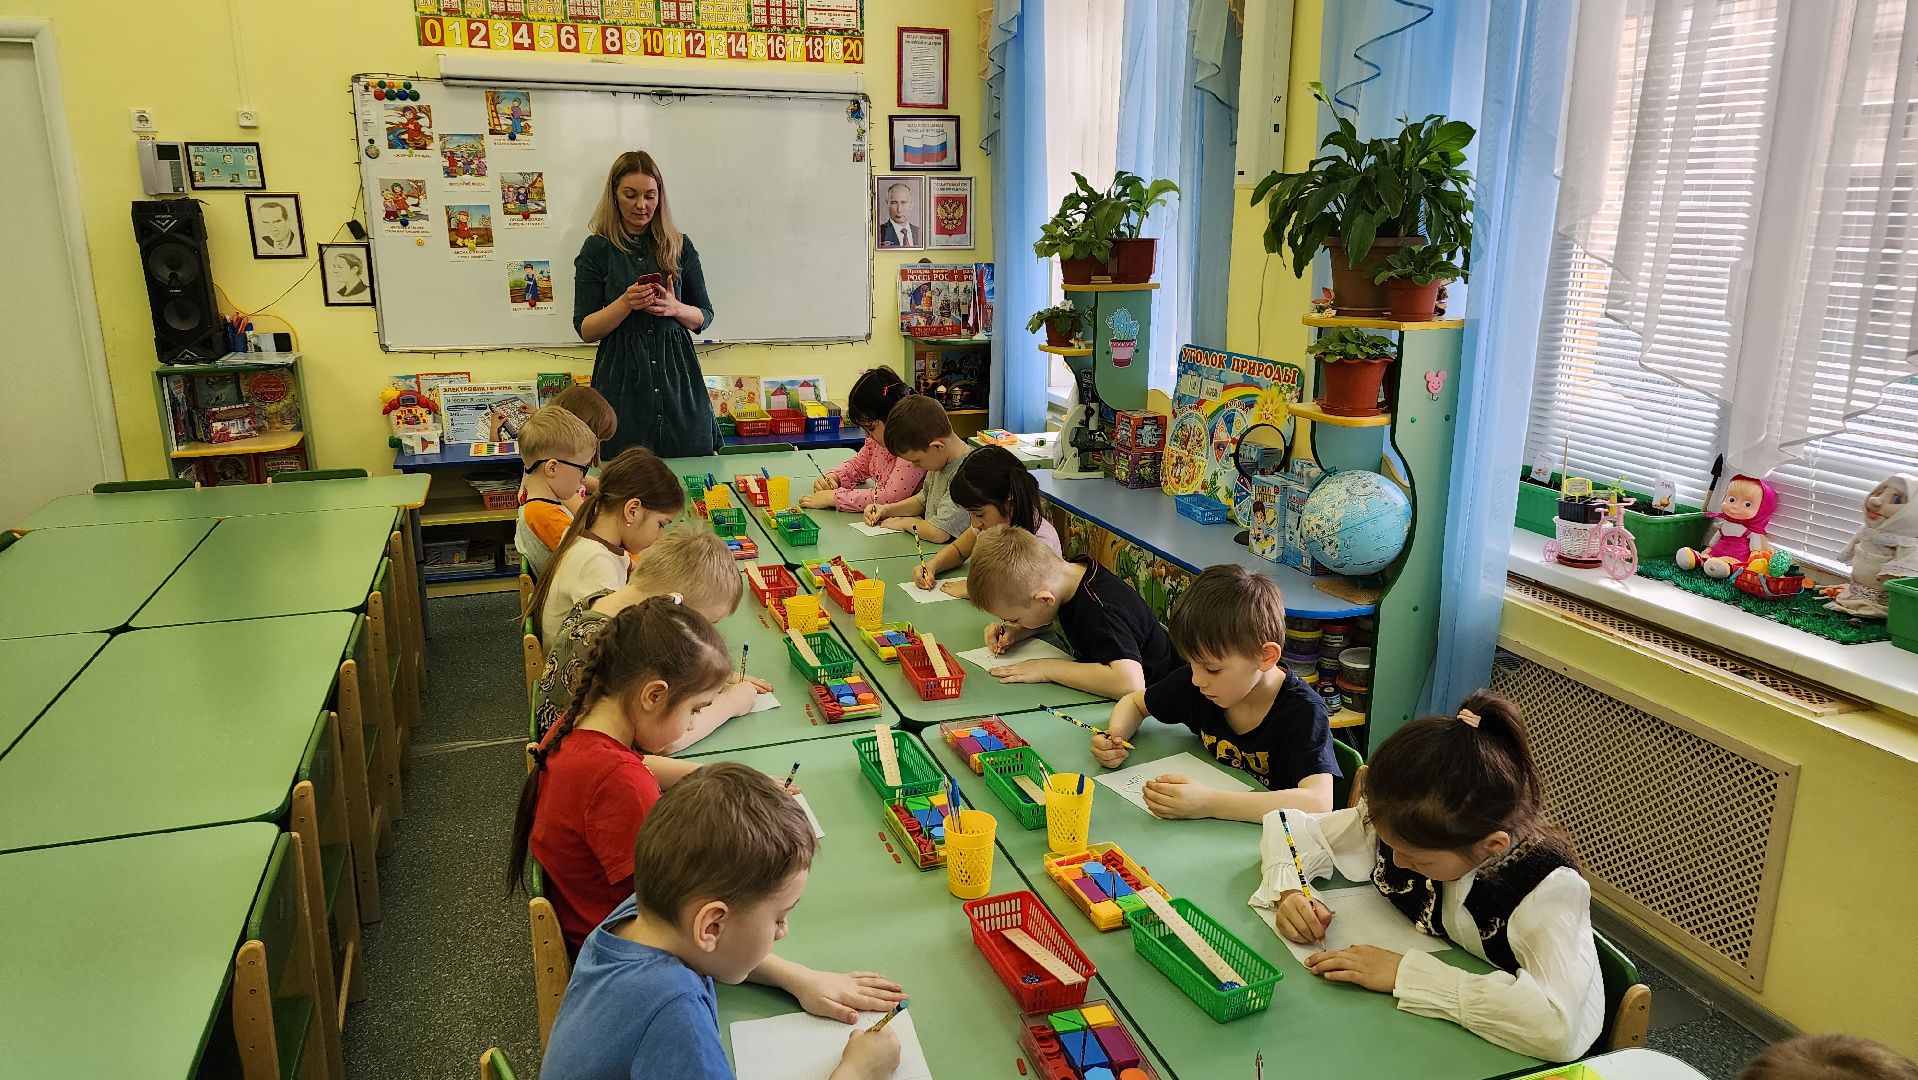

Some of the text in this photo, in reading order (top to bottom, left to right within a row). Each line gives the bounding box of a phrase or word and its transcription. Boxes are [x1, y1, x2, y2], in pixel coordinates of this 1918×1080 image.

[424, 18, 863, 62] 0 1 2 3 4 5 6 7 8 9 10 11 12 13 14 15 16 17 18 19 20
[1182, 347, 1299, 385] УГОЛОК ПРИРОДЫ
